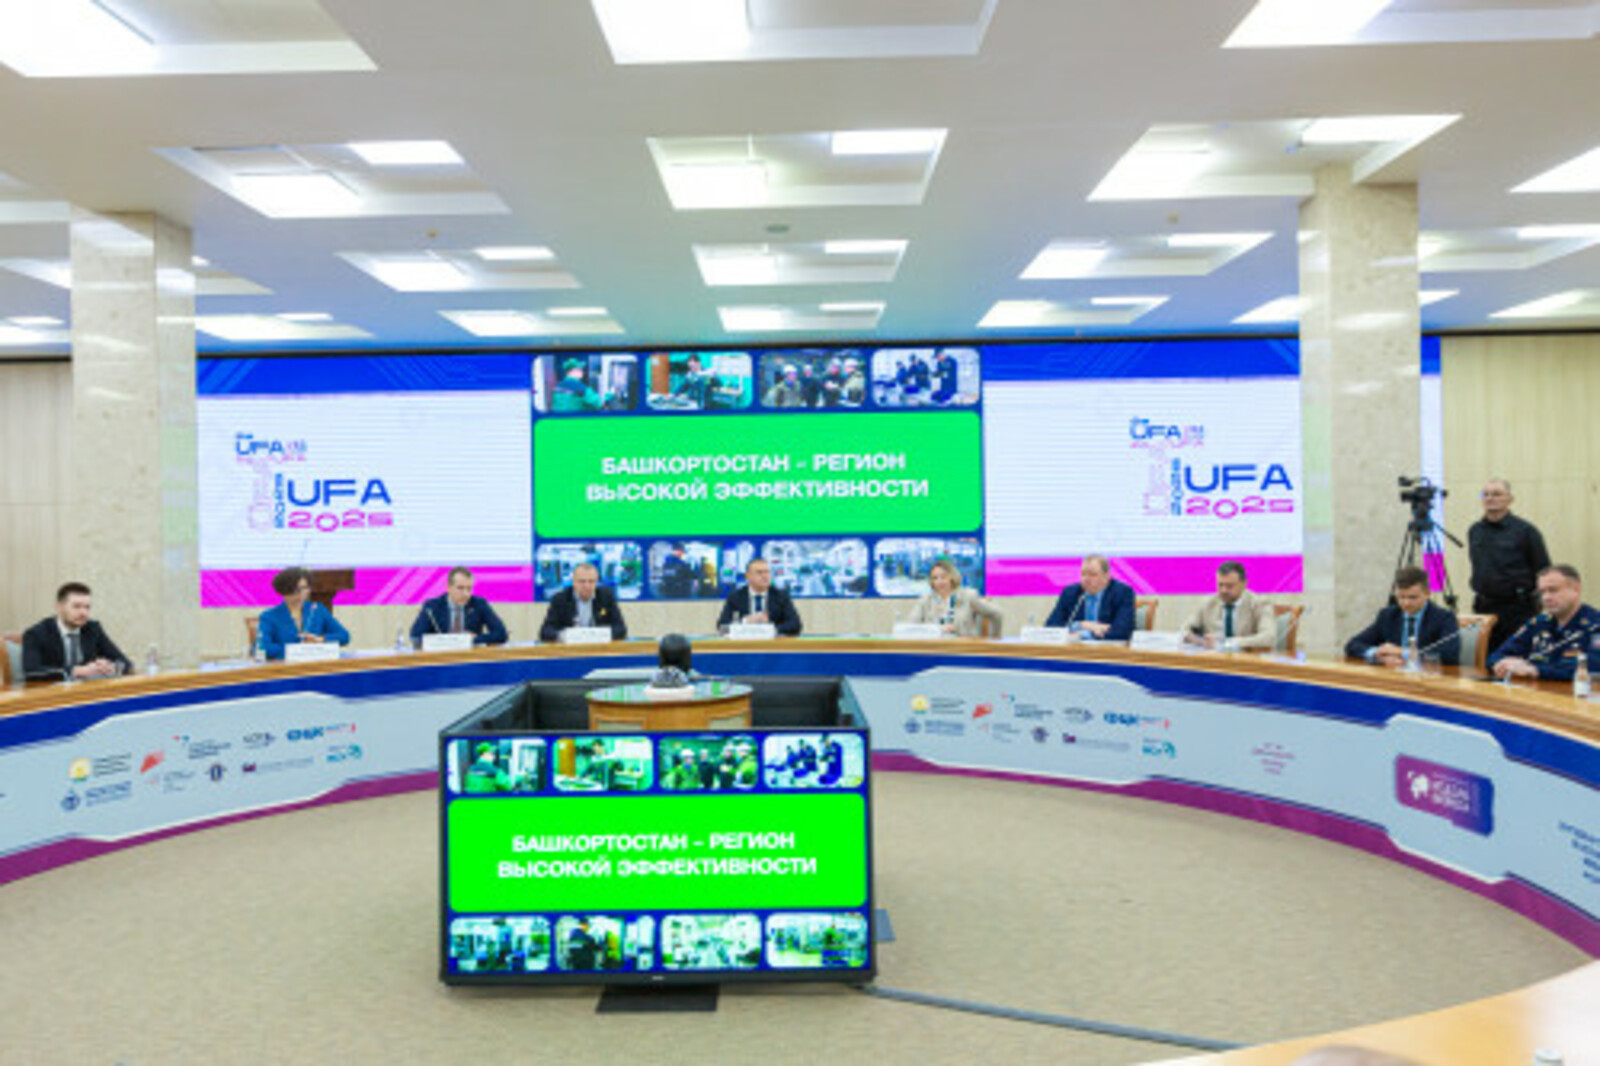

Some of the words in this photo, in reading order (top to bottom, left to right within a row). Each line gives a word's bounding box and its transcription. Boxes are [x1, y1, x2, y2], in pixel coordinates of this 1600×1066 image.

[601, 453, 790, 475] БАШКОРТОСТАН
[812, 452, 906, 471] РЕГИОН
[585, 477, 708, 502] ВЫСОКОЙ
[713, 479, 929, 500] ЭФФЕКТИВНОСТИ
[1184, 463, 1293, 493] UFA
[287, 478, 392, 506] UFA
[1185, 495, 1294, 520] 2025
[287, 508, 394, 532] 2025
[511, 834, 688, 853] БАШКОРТОСТАН
[709, 832, 795, 850] РЕГИОН
[497, 855, 612, 878] ВЫСОКОЙ
[617, 857, 818, 876] ЭФФЕКТИВНОСТИ
